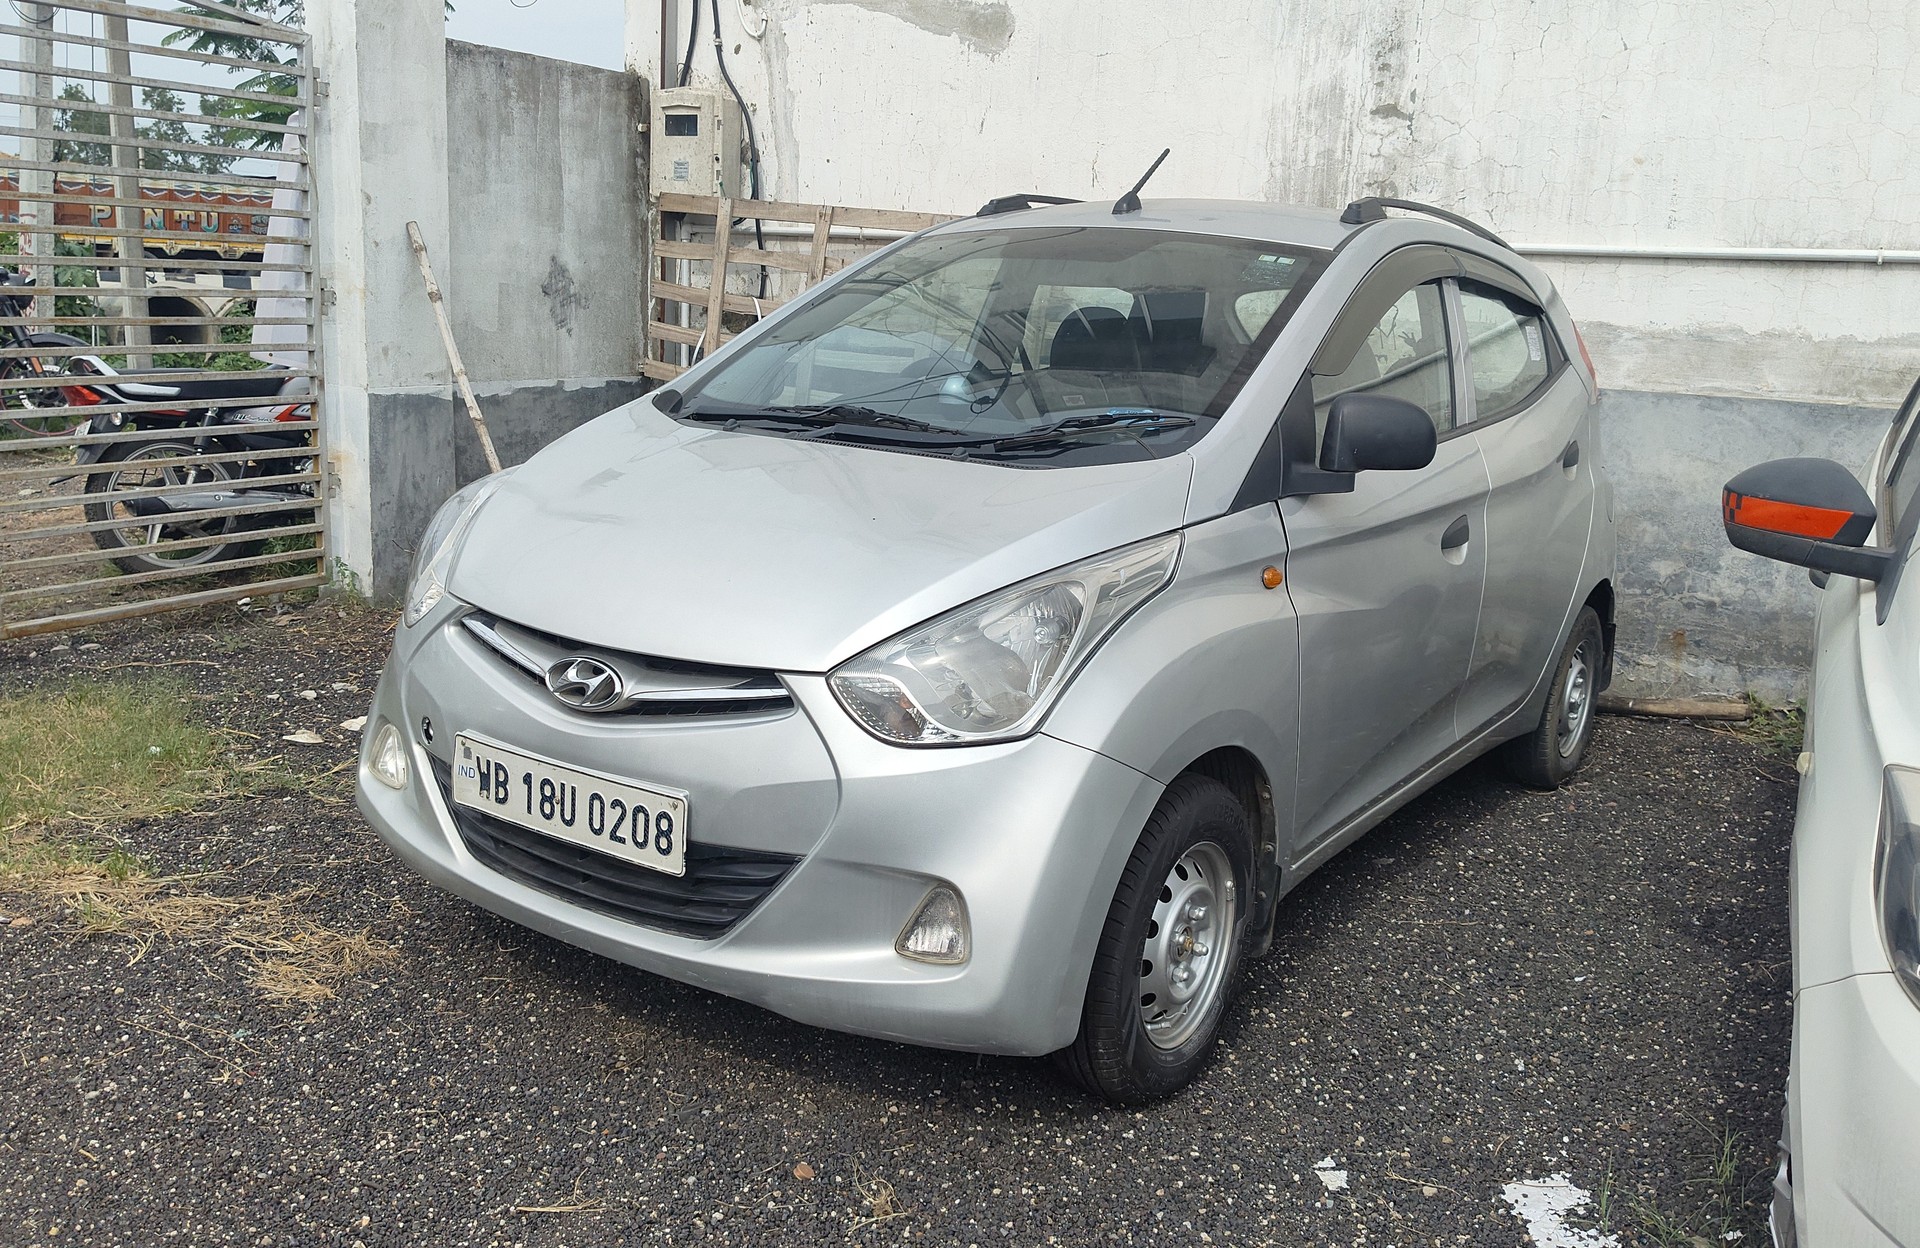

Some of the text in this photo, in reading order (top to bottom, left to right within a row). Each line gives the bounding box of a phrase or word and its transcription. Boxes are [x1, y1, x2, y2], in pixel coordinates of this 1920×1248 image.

[89, 205, 219, 233] PNTU
[457, 764, 476, 779] IND
[476, 755, 673, 856] WB 18U 0208
